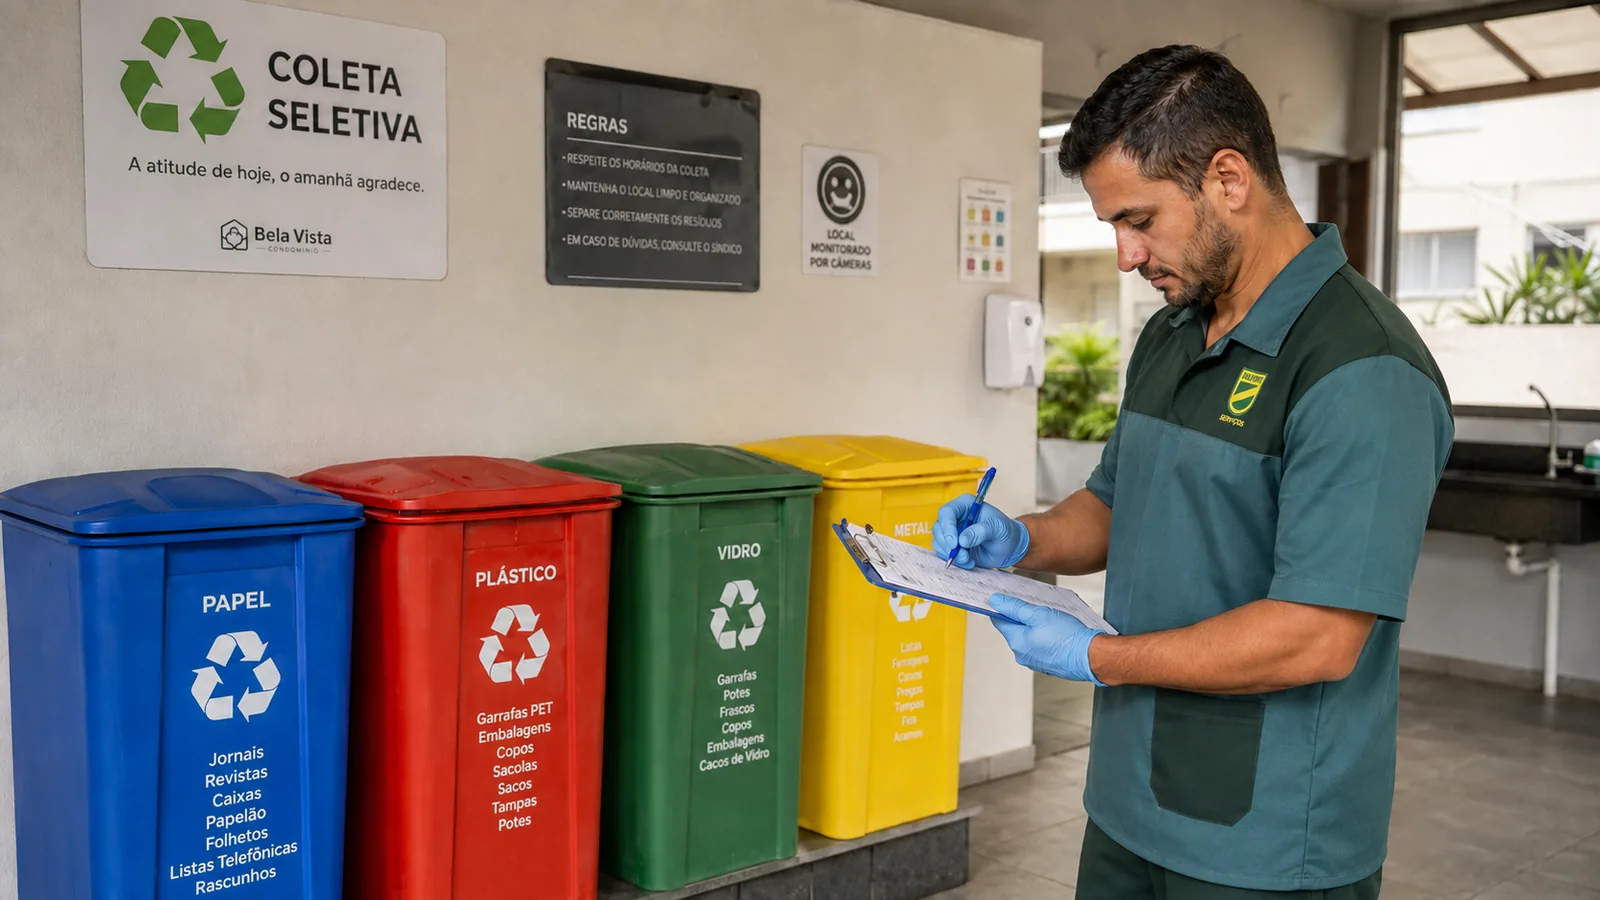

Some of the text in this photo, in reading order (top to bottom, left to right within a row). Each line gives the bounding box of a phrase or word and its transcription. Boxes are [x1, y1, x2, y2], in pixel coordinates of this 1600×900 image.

[269, 51, 402, 96] COLETA
[268, 99, 422, 143] SELETIVA
[568, 112, 628, 134] REGRAS
[128, 157, 424, 192] A atitude de hoje, o amanhã agradece.
[568, 154, 709, 177] RESPEITE OS HORÁRIOS DA COLETA
[568, 180, 741, 206] MANTENHA O LOCAL LIMPO E ORGANIZADO
[568, 207, 722, 228] SEPARE CORRETAMENTE OS RESÍDUOS
[255, 227, 332, 245] Bela Vista
[568, 235, 742, 254] EM CASO DE DÚVIDAS, CONSULTE O SÍNDICO
[828, 229, 855, 241] LOCAL
[811, 243, 871, 255] MONITORADO
[810, 256, 871, 270] POR CÂMERAS
[894, 521, 932, 537] METAL
[718, 543, 761, 560] VIDRO
[476, 565, 557, 587] PLÁSTICO
[203, 591, 271, 613] PAPEL
[717, 670, 757, 685] Garrafas
[724, 688, 750, 701] Potes
[477, 702, 553, 725] Garrafas PET
[720, 704, 755, 718] Frascos
[479, 722, 551, 743] Embalagens
[722, 720, 752, 735] Copos
[497, 742, 534, 760] Copos
[707, 733, 764, 753] Embalagens
[209, 746, 264, 767] Jornais
[699, 747, 769, 771] Cacos de Vidro
[206, 768, 268, 788] Revistas
[493, 759, 537, 778] Sacolas
[498, 779, 532, 795] Sacos
[213, 789, 262, 807] Caixas
[492, 795, 537, 814] Tampas
[206, 807, 266, 829] Papelão
[498, 815, 531, 831] Potes
[206, 829, 268, 851] Folhetos
[170, 842, 298, 879] Listas Telefônicas
[196, 868, 276, 895] Rascunhos
